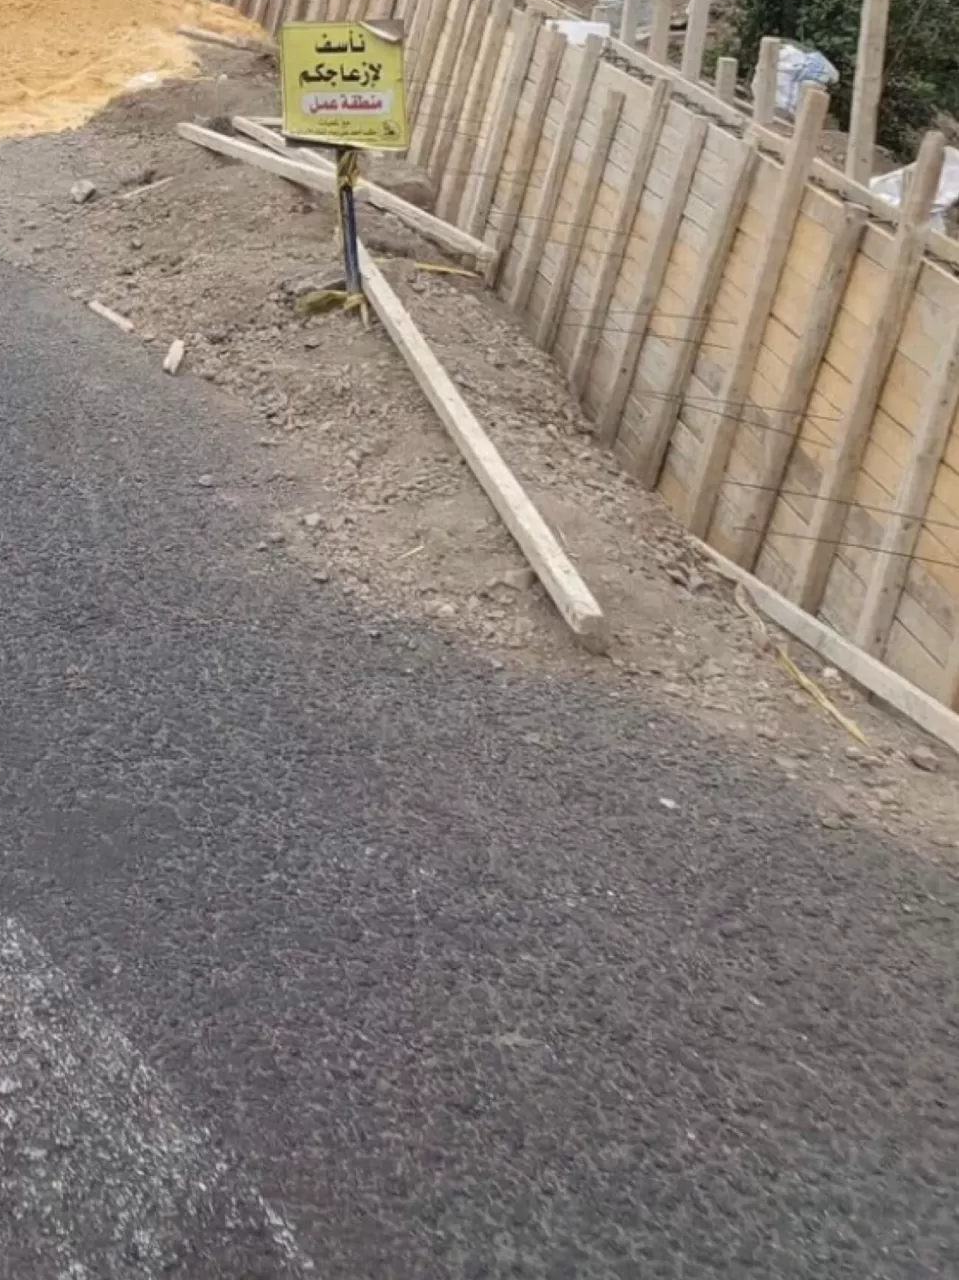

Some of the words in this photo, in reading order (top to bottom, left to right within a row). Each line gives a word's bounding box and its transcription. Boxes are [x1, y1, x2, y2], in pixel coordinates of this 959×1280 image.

[315, 30, 366, 53] نأسف
[298, 62, 382, 88] لإزعاجكم
[308, 96, 338, 114] عمل
[341, 94, 383, 110] منطقة
